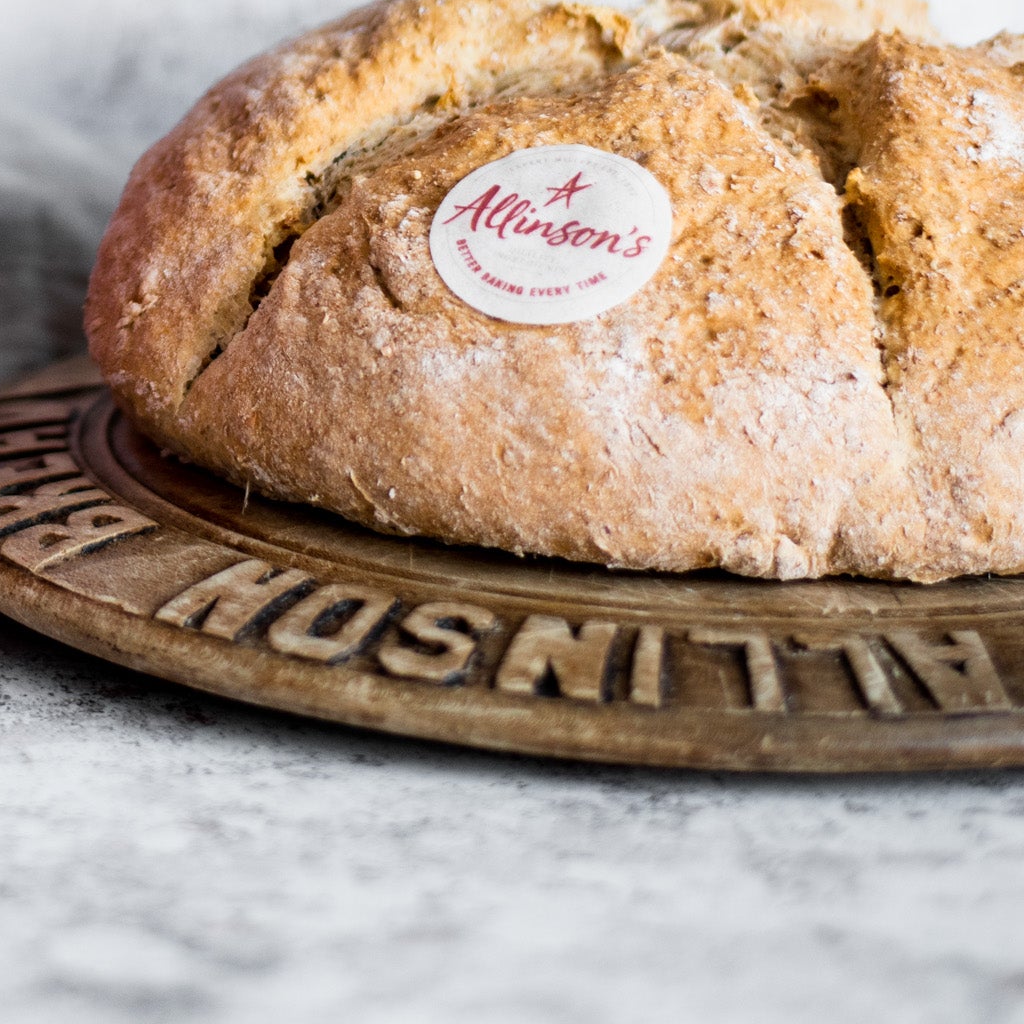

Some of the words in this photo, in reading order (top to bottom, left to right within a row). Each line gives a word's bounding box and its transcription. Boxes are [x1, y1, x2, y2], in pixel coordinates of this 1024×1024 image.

[442, 184, 652, 259] Allinson's
[456, 238, 482, 273] BETTER
[481, 271, 524, 296] BAKING
[529, 285, 570, 297] EVERY
[575, 271, 608, 291] TIME
[155, 559, 1013, 716] ALLINSON
